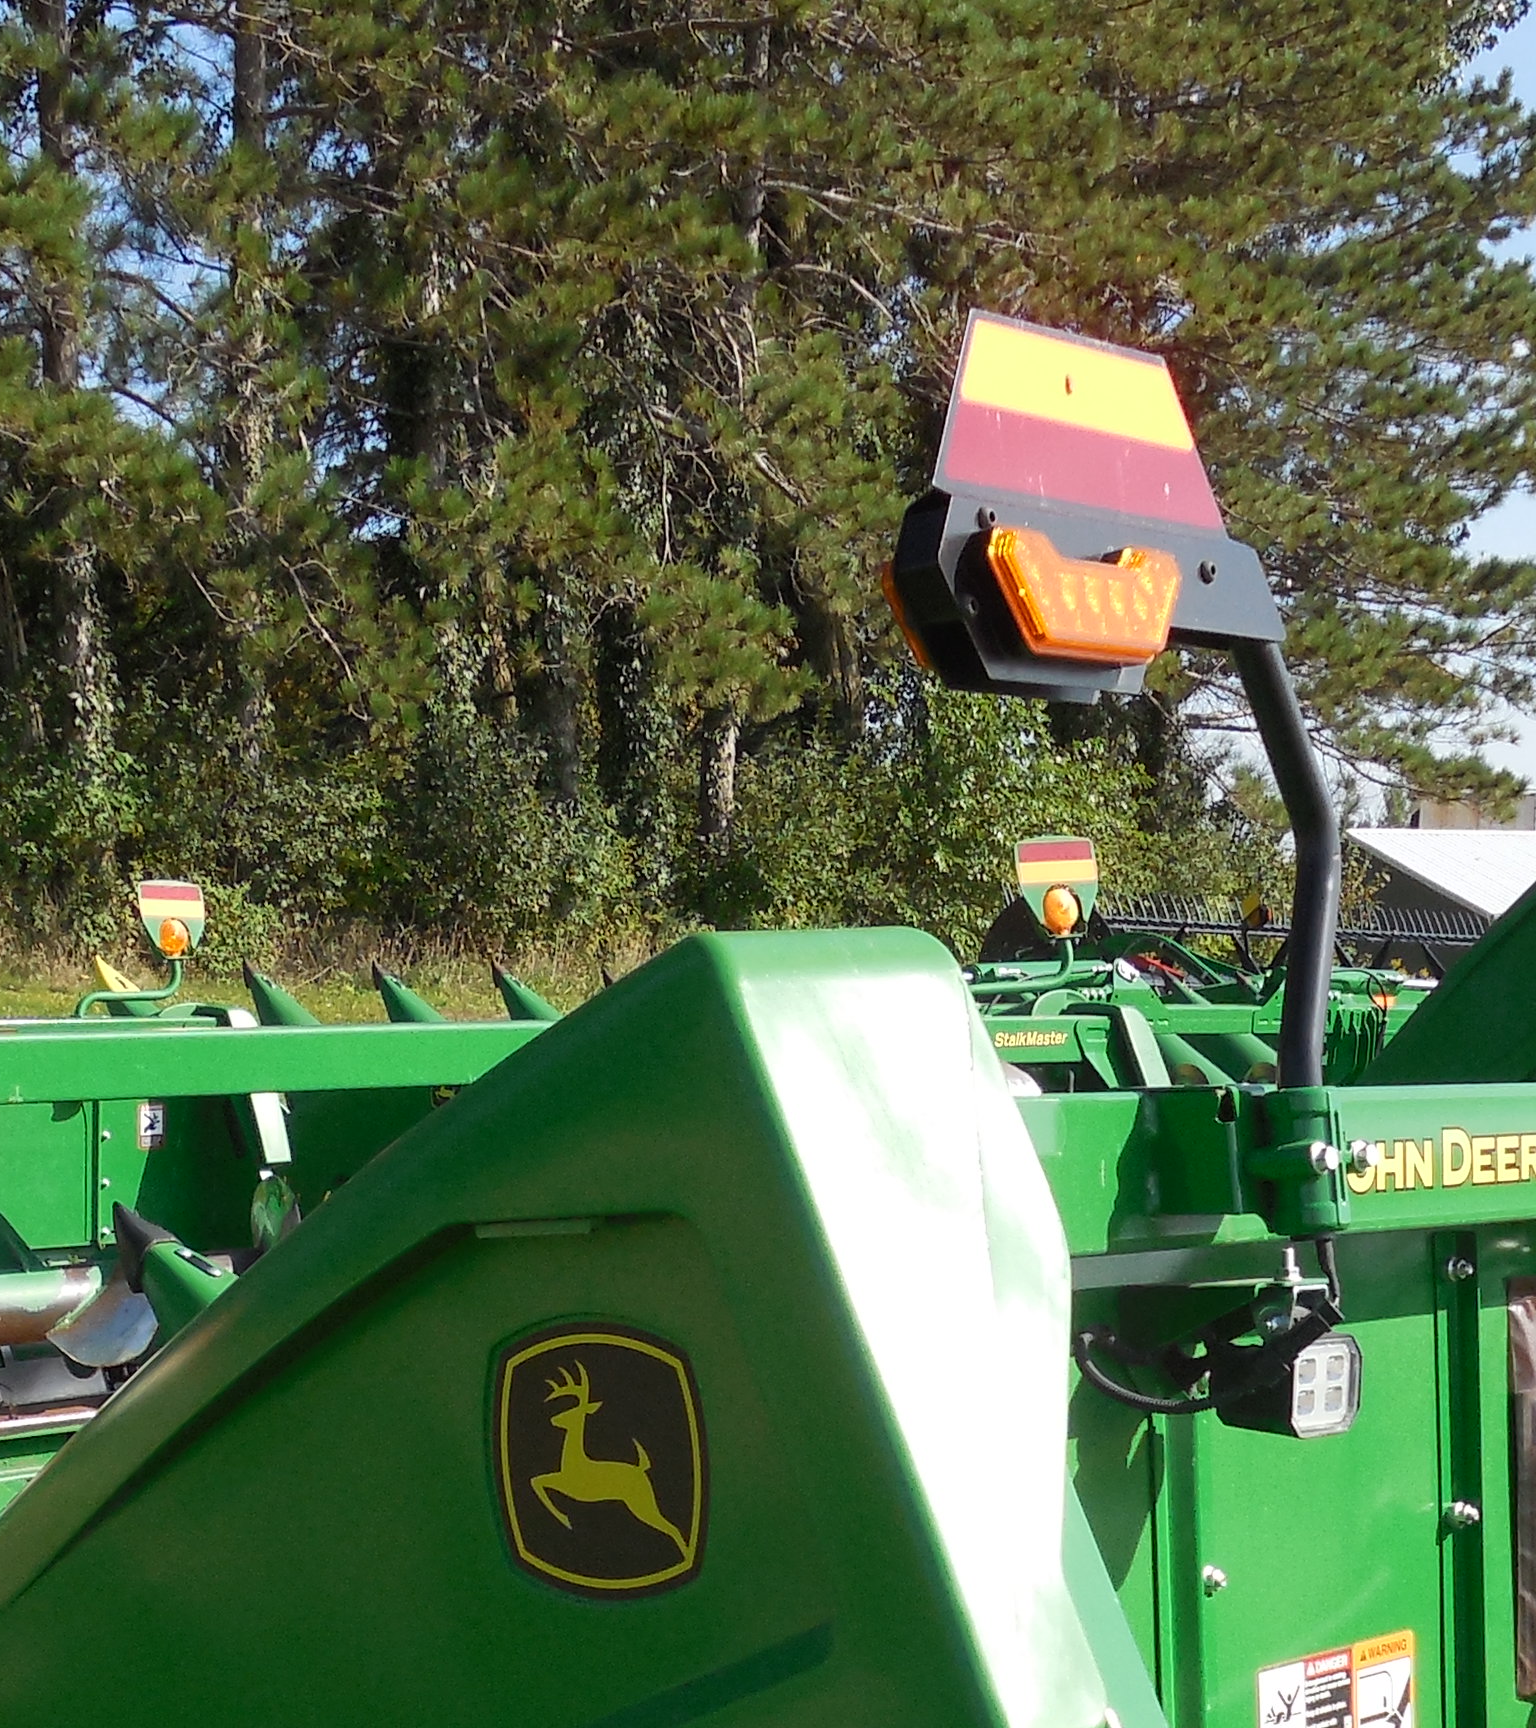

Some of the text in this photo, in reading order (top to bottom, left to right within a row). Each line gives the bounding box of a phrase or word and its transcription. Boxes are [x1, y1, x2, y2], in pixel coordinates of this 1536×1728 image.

[994, 1031, 1068, 1047] StalkMaster
[1368, 1639, 1407, 1659] WARNING
[1315, 1654, 1348, 1675] DANGER
